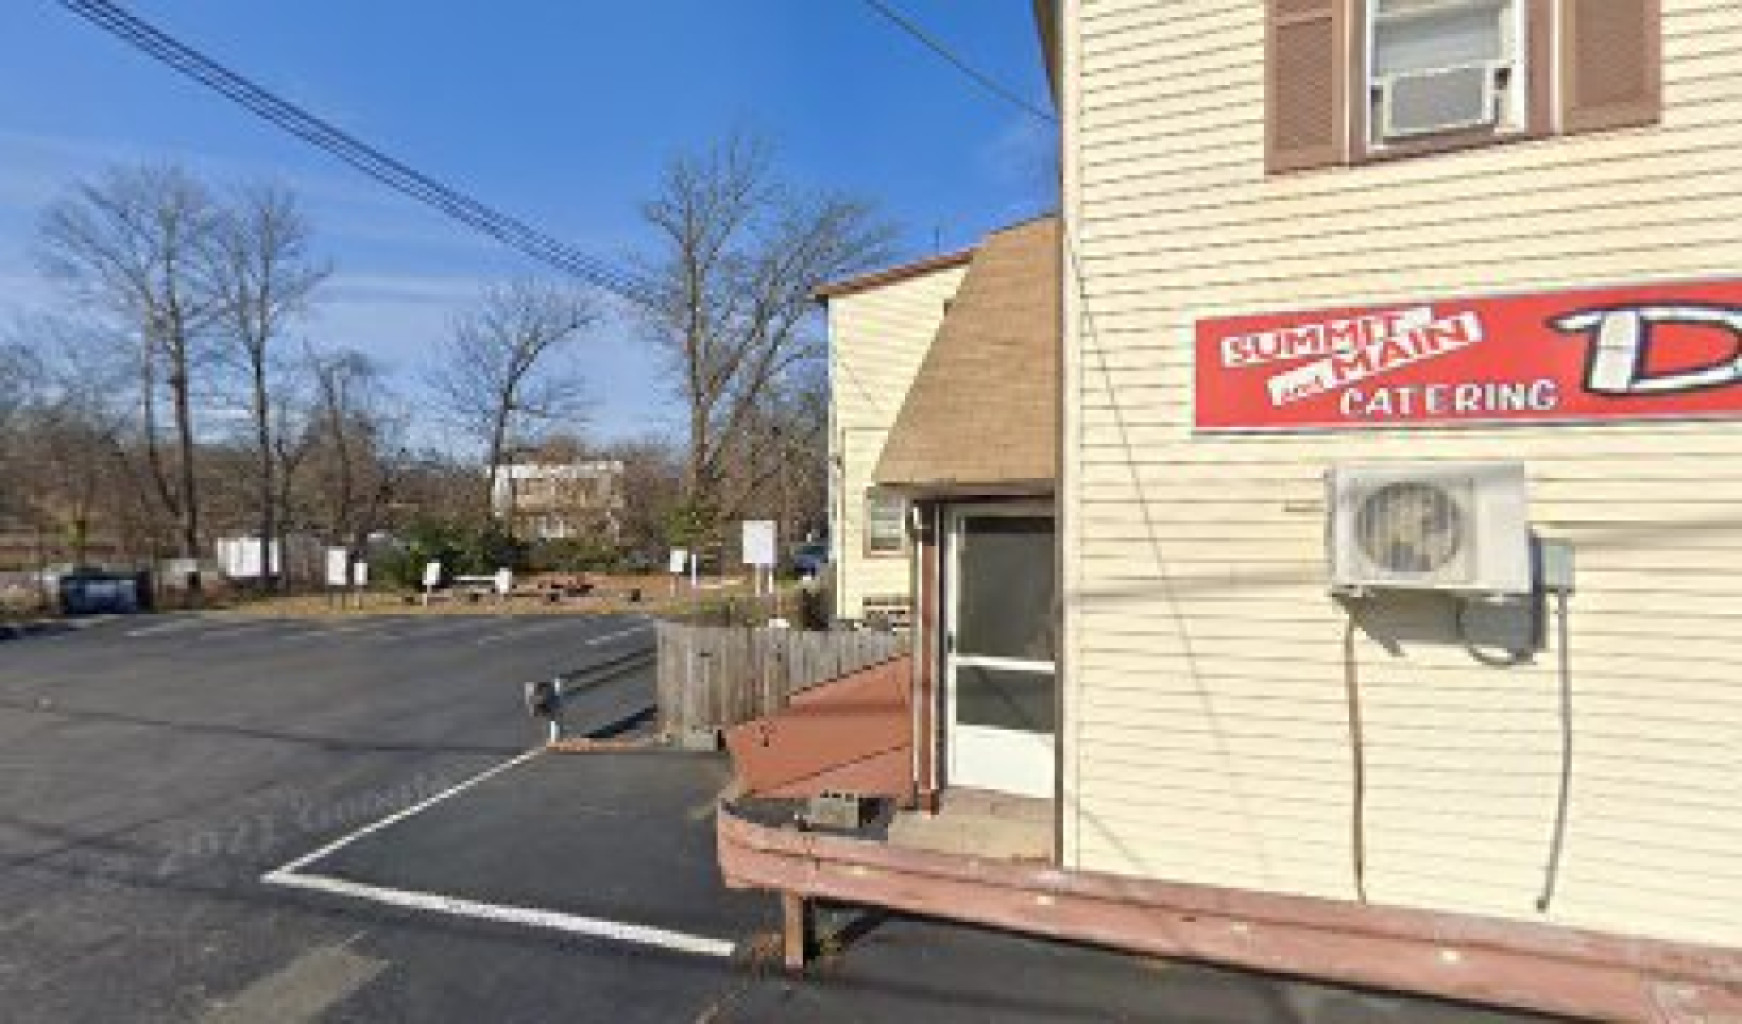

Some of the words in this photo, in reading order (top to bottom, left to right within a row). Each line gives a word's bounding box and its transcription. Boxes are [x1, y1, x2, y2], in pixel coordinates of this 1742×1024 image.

[1229, 314, 1402, 365] SUMMIT
[1331, 318, 1471, 381] MAIN
[1340, 379, 1558, 416] CATERING
